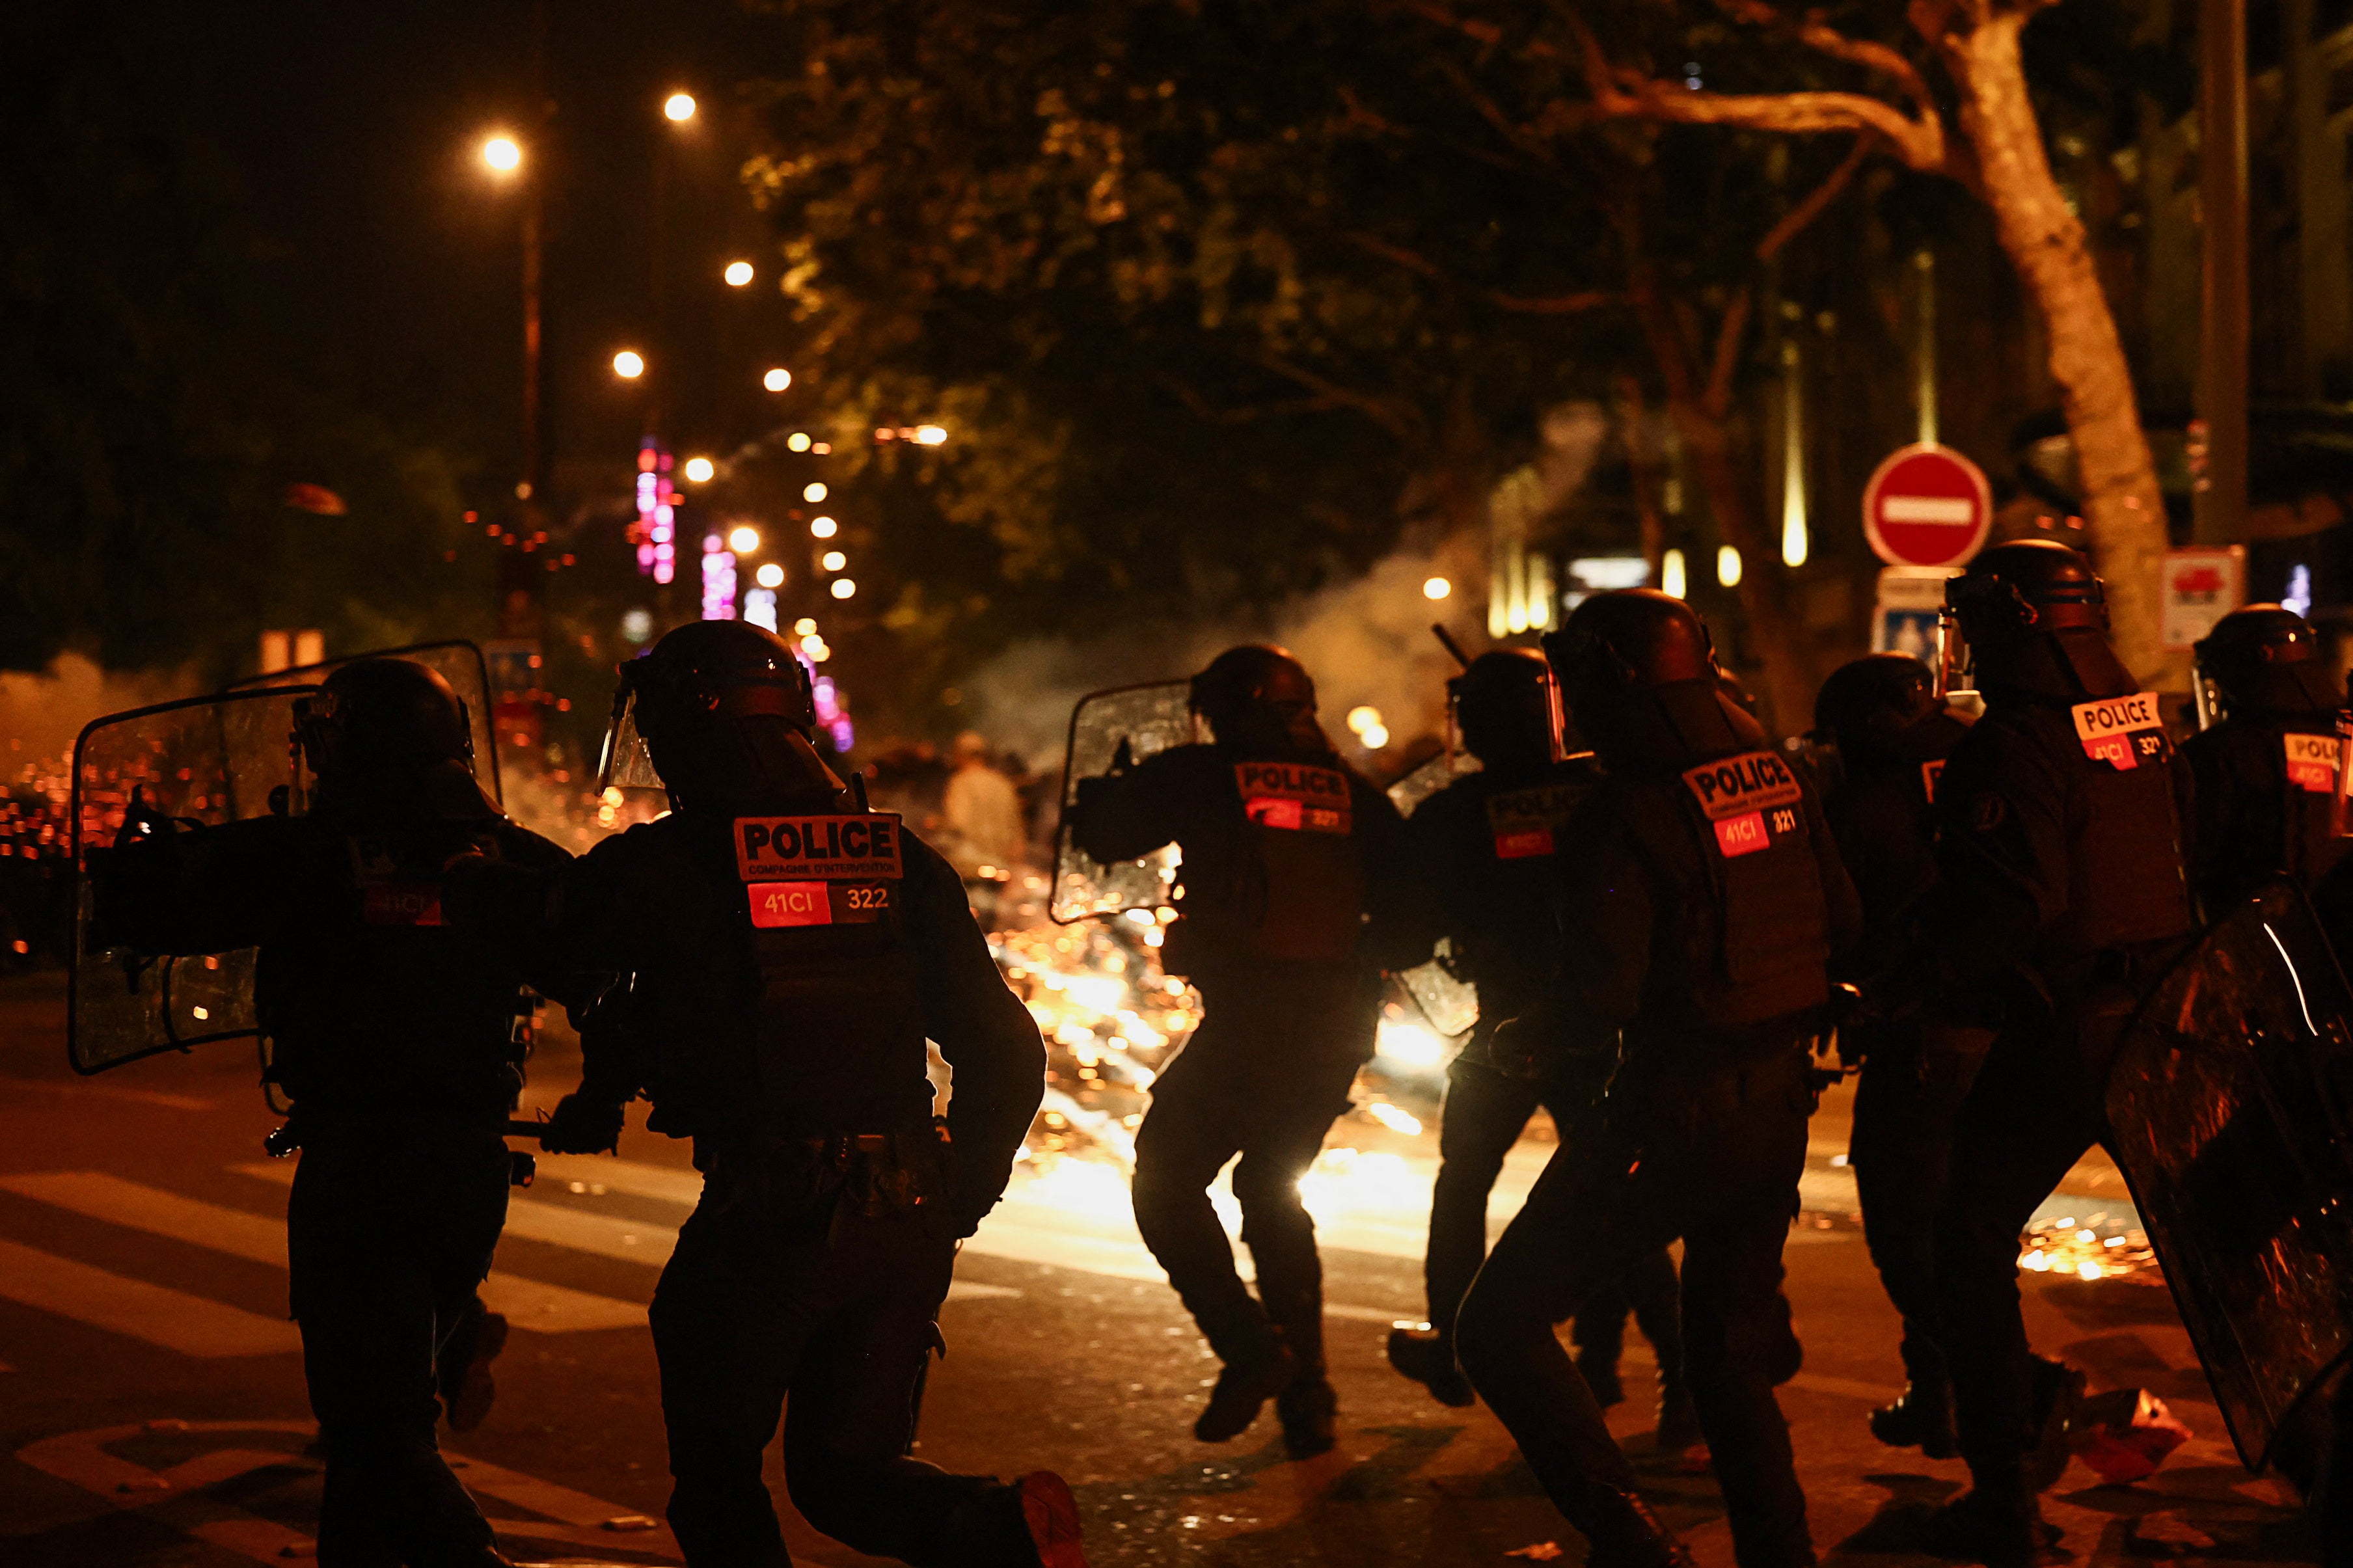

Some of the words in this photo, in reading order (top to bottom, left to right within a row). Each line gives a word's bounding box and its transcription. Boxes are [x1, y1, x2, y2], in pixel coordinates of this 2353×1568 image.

[2084, 701, 2150, 732] POLICE
[2295, 740, 2341, 760] POLI
[1244, 767, 1345, 796] POLICE
[1694, 758, 1790, 803] POLICE
[744, 821, 894, 860] POLICE
[1726, 818, 1757, 844] 41CI
[748, 864, 810, 874] COMPAGNIE
[765, 892, 813, 913] 41CI
[847, 888, 890, 909] 322
